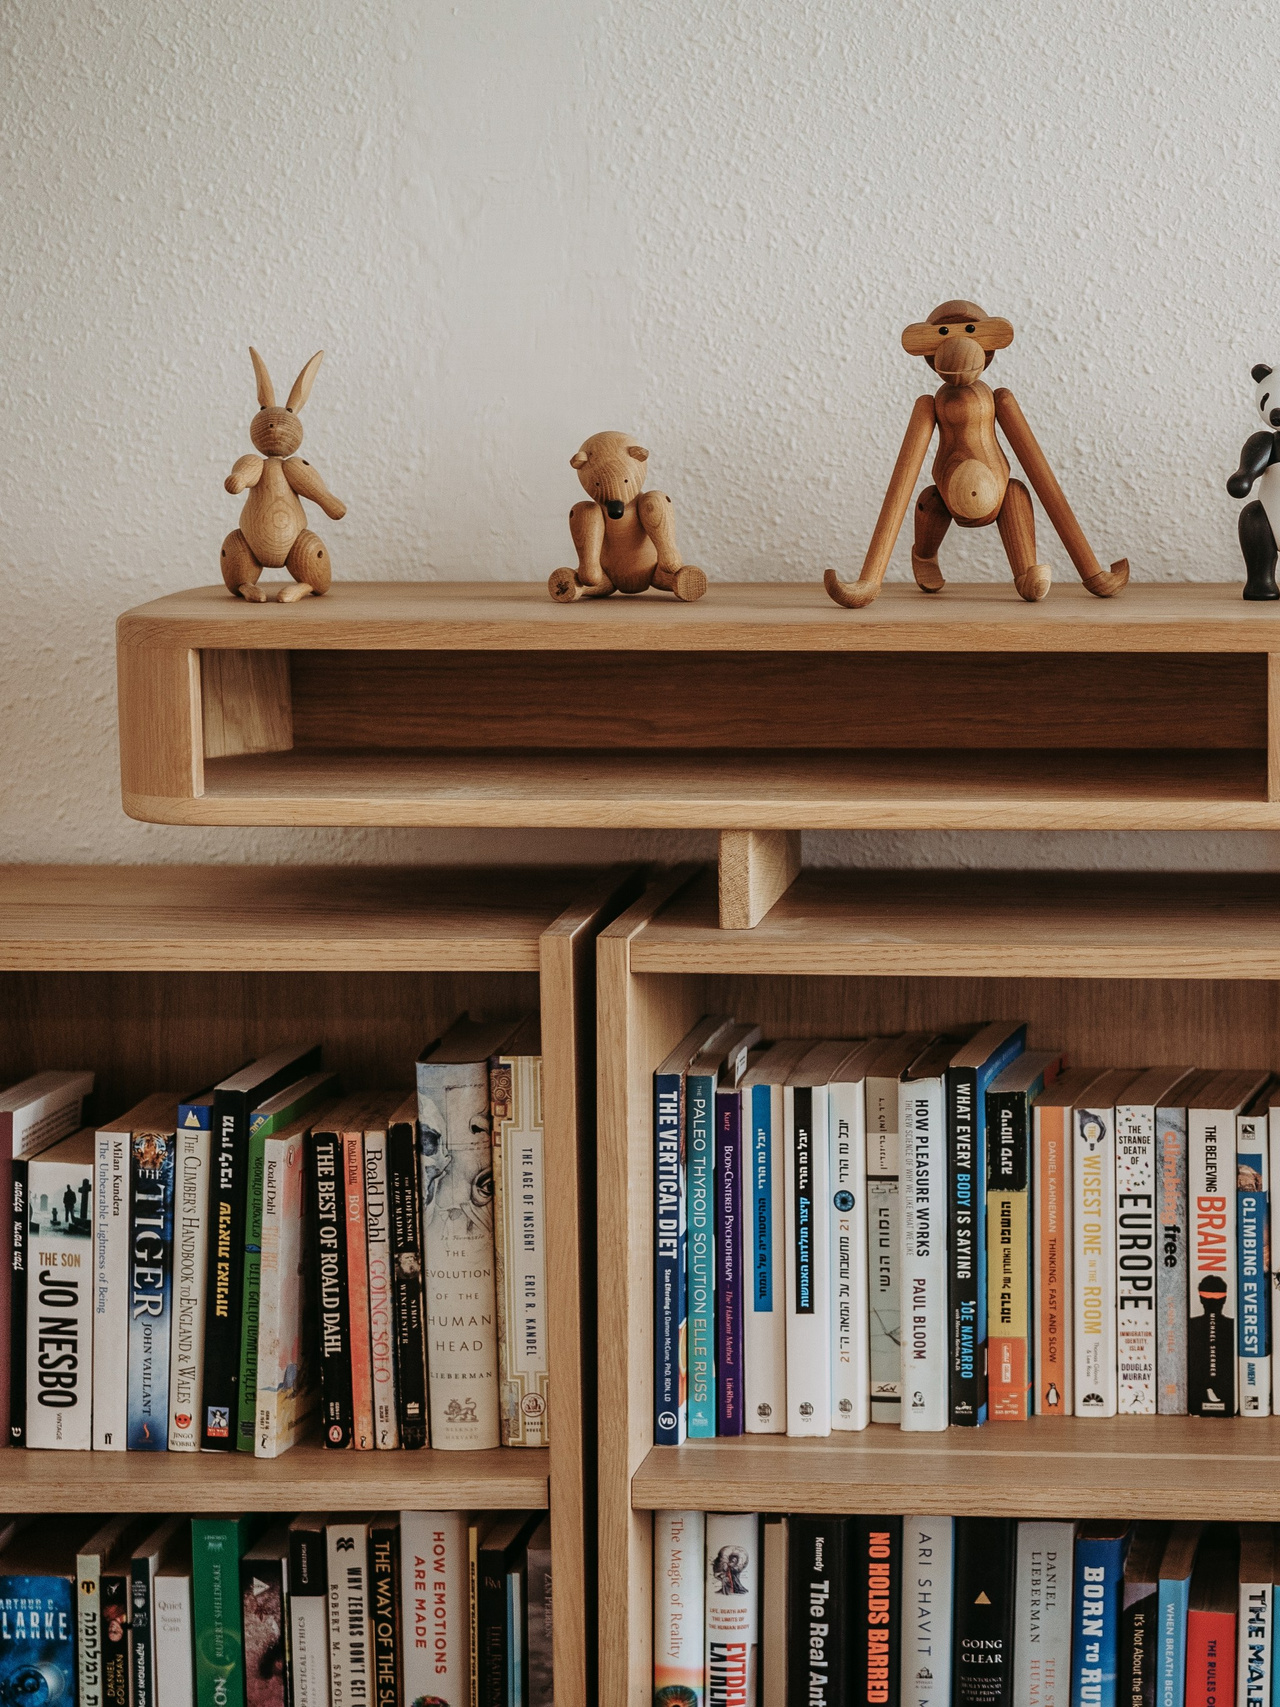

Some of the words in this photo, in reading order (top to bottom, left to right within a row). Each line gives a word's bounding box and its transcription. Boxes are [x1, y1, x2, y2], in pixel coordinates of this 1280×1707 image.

[659, 1091, 677, 1125] THE
[916, 1100, 928, 1131] HOW
[957, 1083, 970, 1120] WHAT
[694, 1099, 706, 1151] PALEO
[1119, 1136, 1150, 1144] STRANGE
[1205, 1126, 1216, 1143] THE
[100, 1140, 109, 1159] The
[114, 1141, 122, 1164] Milan
[317, 1143, 334, 1177] THE
[522, 1148, 533, 1165] THE
[957, 1126, 970, 1168] EVERY
[1048, 1141, 1056, 1175] DANIEL
[1124, 1146, 1146, 1154] DEATH
[139, 1169, 162, 1179] THE
[364, 1149, 384, 1195] Roald
[523, 1172, 533, 1188] AGE
[659, 1129, 677, 1214] VERTICAL
[916, 1137, 929, 1203] PLEASURE
[1206, 1146, 1217, 1192] BELIEVING
[99, 1163, 109, 1219] Unbearable
[113, 1175, 122, 1216] Kundera
[318, 1181, 336, 1221] BEST
[523, 1195, 533, 1205] OF
[694, 1156, 706, 1227] THYROID
[957, 1174, 970, 1206] BODY
[1048, 1178, 1056, 1232] KAHNEMAN
[320, 1226, 337, 1248] OF
[367, 1201, 386, 1243] Dahl
[524, 1212, 534, 1251] INSIGHT
[917, 1208, 929, 1256] WORKS
[957, 1211, 971, 1223] IS
[1197, 1196, 1227, 1271] BRAIN
[1243, 1198, 1257, 1275] CLIMBING
[97, 1223, 109, 1269] Lightness
[132, 1184, 165, 1320] TIGER
[659, 1219, 677, 1259] DIET
[957, 1229, 971, 1278] SAYING
[1119, 1194, 1152, 1310] EUROPE
[39, 1252, 58, 1266] THE
[61, 1253, 80, 1267] SON
[99, 1273, 108, 1283] of
[694, 1233, 706, 1313] SOLUTION
[1048, 1238, 1056, 1285] THINKING,
[39, 1270, 78, 1307] JO
[96, 1287, 108, 1314] Being
[321, 1253, 339, 1308] ROALD
[370, 1260, 388, 1326] GOING
[525, 1275, 535, 1297] ERIC
[913, 1279, 926, 1311] PAUL
[526, 1303, 536, 1312] R.
[1244, 1283, 1258, 1354] EVEREST
[142, 1322, 152, 1354] JOHN
[323, 1313, 341, 1357] DAHL
[526, 1319, 537, 1355] KANDEL
[694, 1319, 707, 1356] ELLE
[913, 1316, 926, 1359] BLOOM
[961, 1331, 973, 1378] NAVARRO
[1049, 1337, 1057, 1363] SLOW
[38, 1317, 78, 1407] NESBO
[372, 1332, 390, 1383] SOLO
[142, 1358, 151, 1417] VAILLANT
[694, 1362, 707, 1402] RUSS
[726, 1378, 734, 1418] LifeRhythm
[669, 1518, 684, 1542] The
[869, 1533, 890, 1558] NO
[433, 1532, 445, 1573] HOW
[667, 1549, 682, 1587] Magic
[415, 1556, 426, 1590] ARE
[1046, 1552, 1057, 1610] DANIEL
[671, 1594, 683, 1607] of
[868, 1563, 889, 1624] HOLDS
[1031, 1552, 1042, 1642] LIEBERMAN
[1083, 1567, 1104, 1637] BORN
[415, 1599, 426, 1648] MADE
[434, 1582, 447, 1674] EMOTIONS
[667, 1614, 683, 1658] Reality
[961, 1639, 1003, 1649] GOING
[962, 1654, 1002, 1663] CLEAR
[1086, 1643, 1099, 1662] TO
[868, 1629, 889, 1702] BARRED
